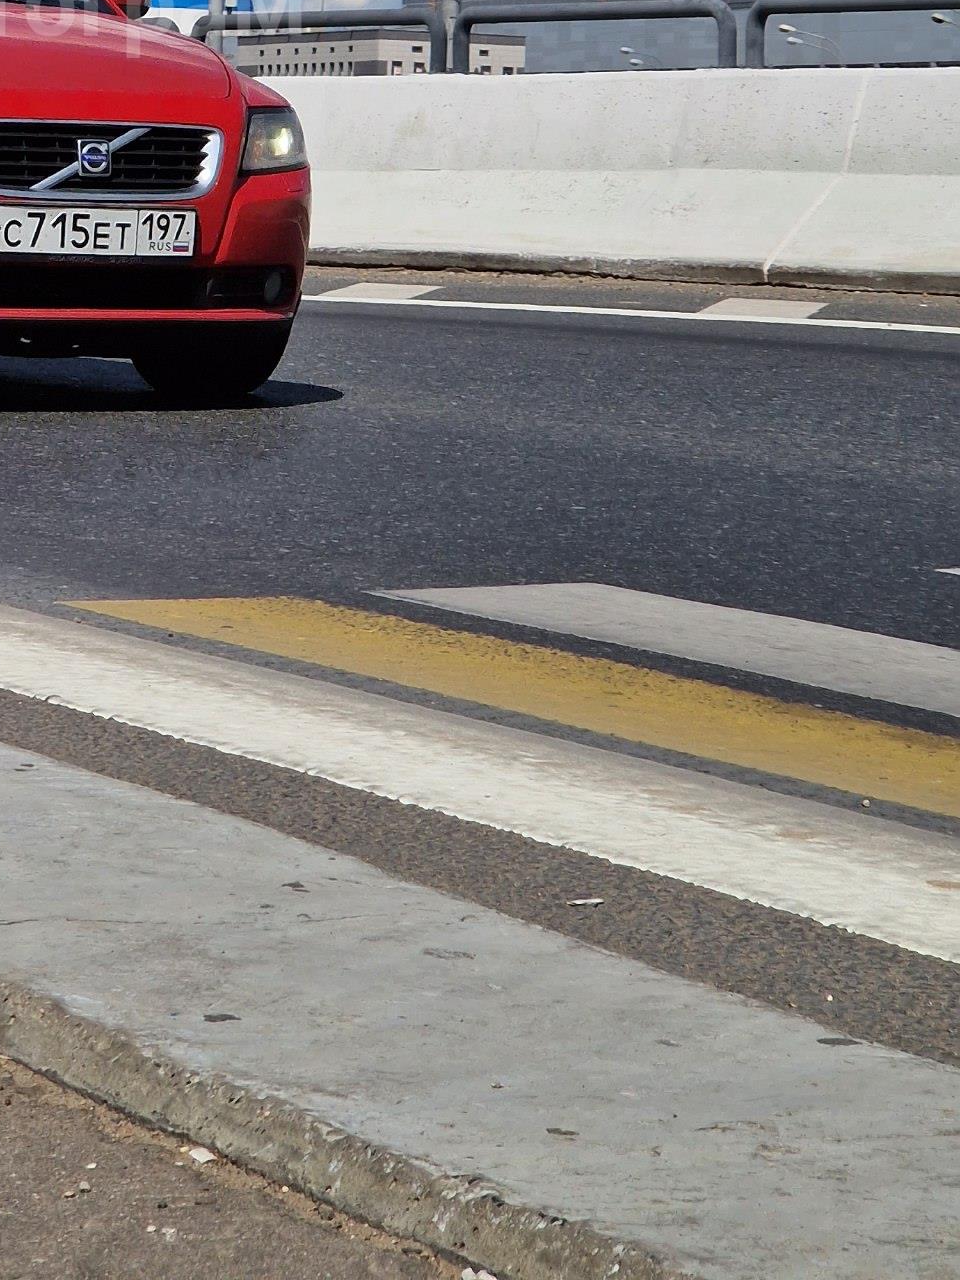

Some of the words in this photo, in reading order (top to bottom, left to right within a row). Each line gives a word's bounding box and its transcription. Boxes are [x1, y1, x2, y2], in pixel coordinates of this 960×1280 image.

[3, 212, 132, 250] С715ЕТ
[141, 213, 186, 241] 197
[148, 241, 172, 252] RUS
